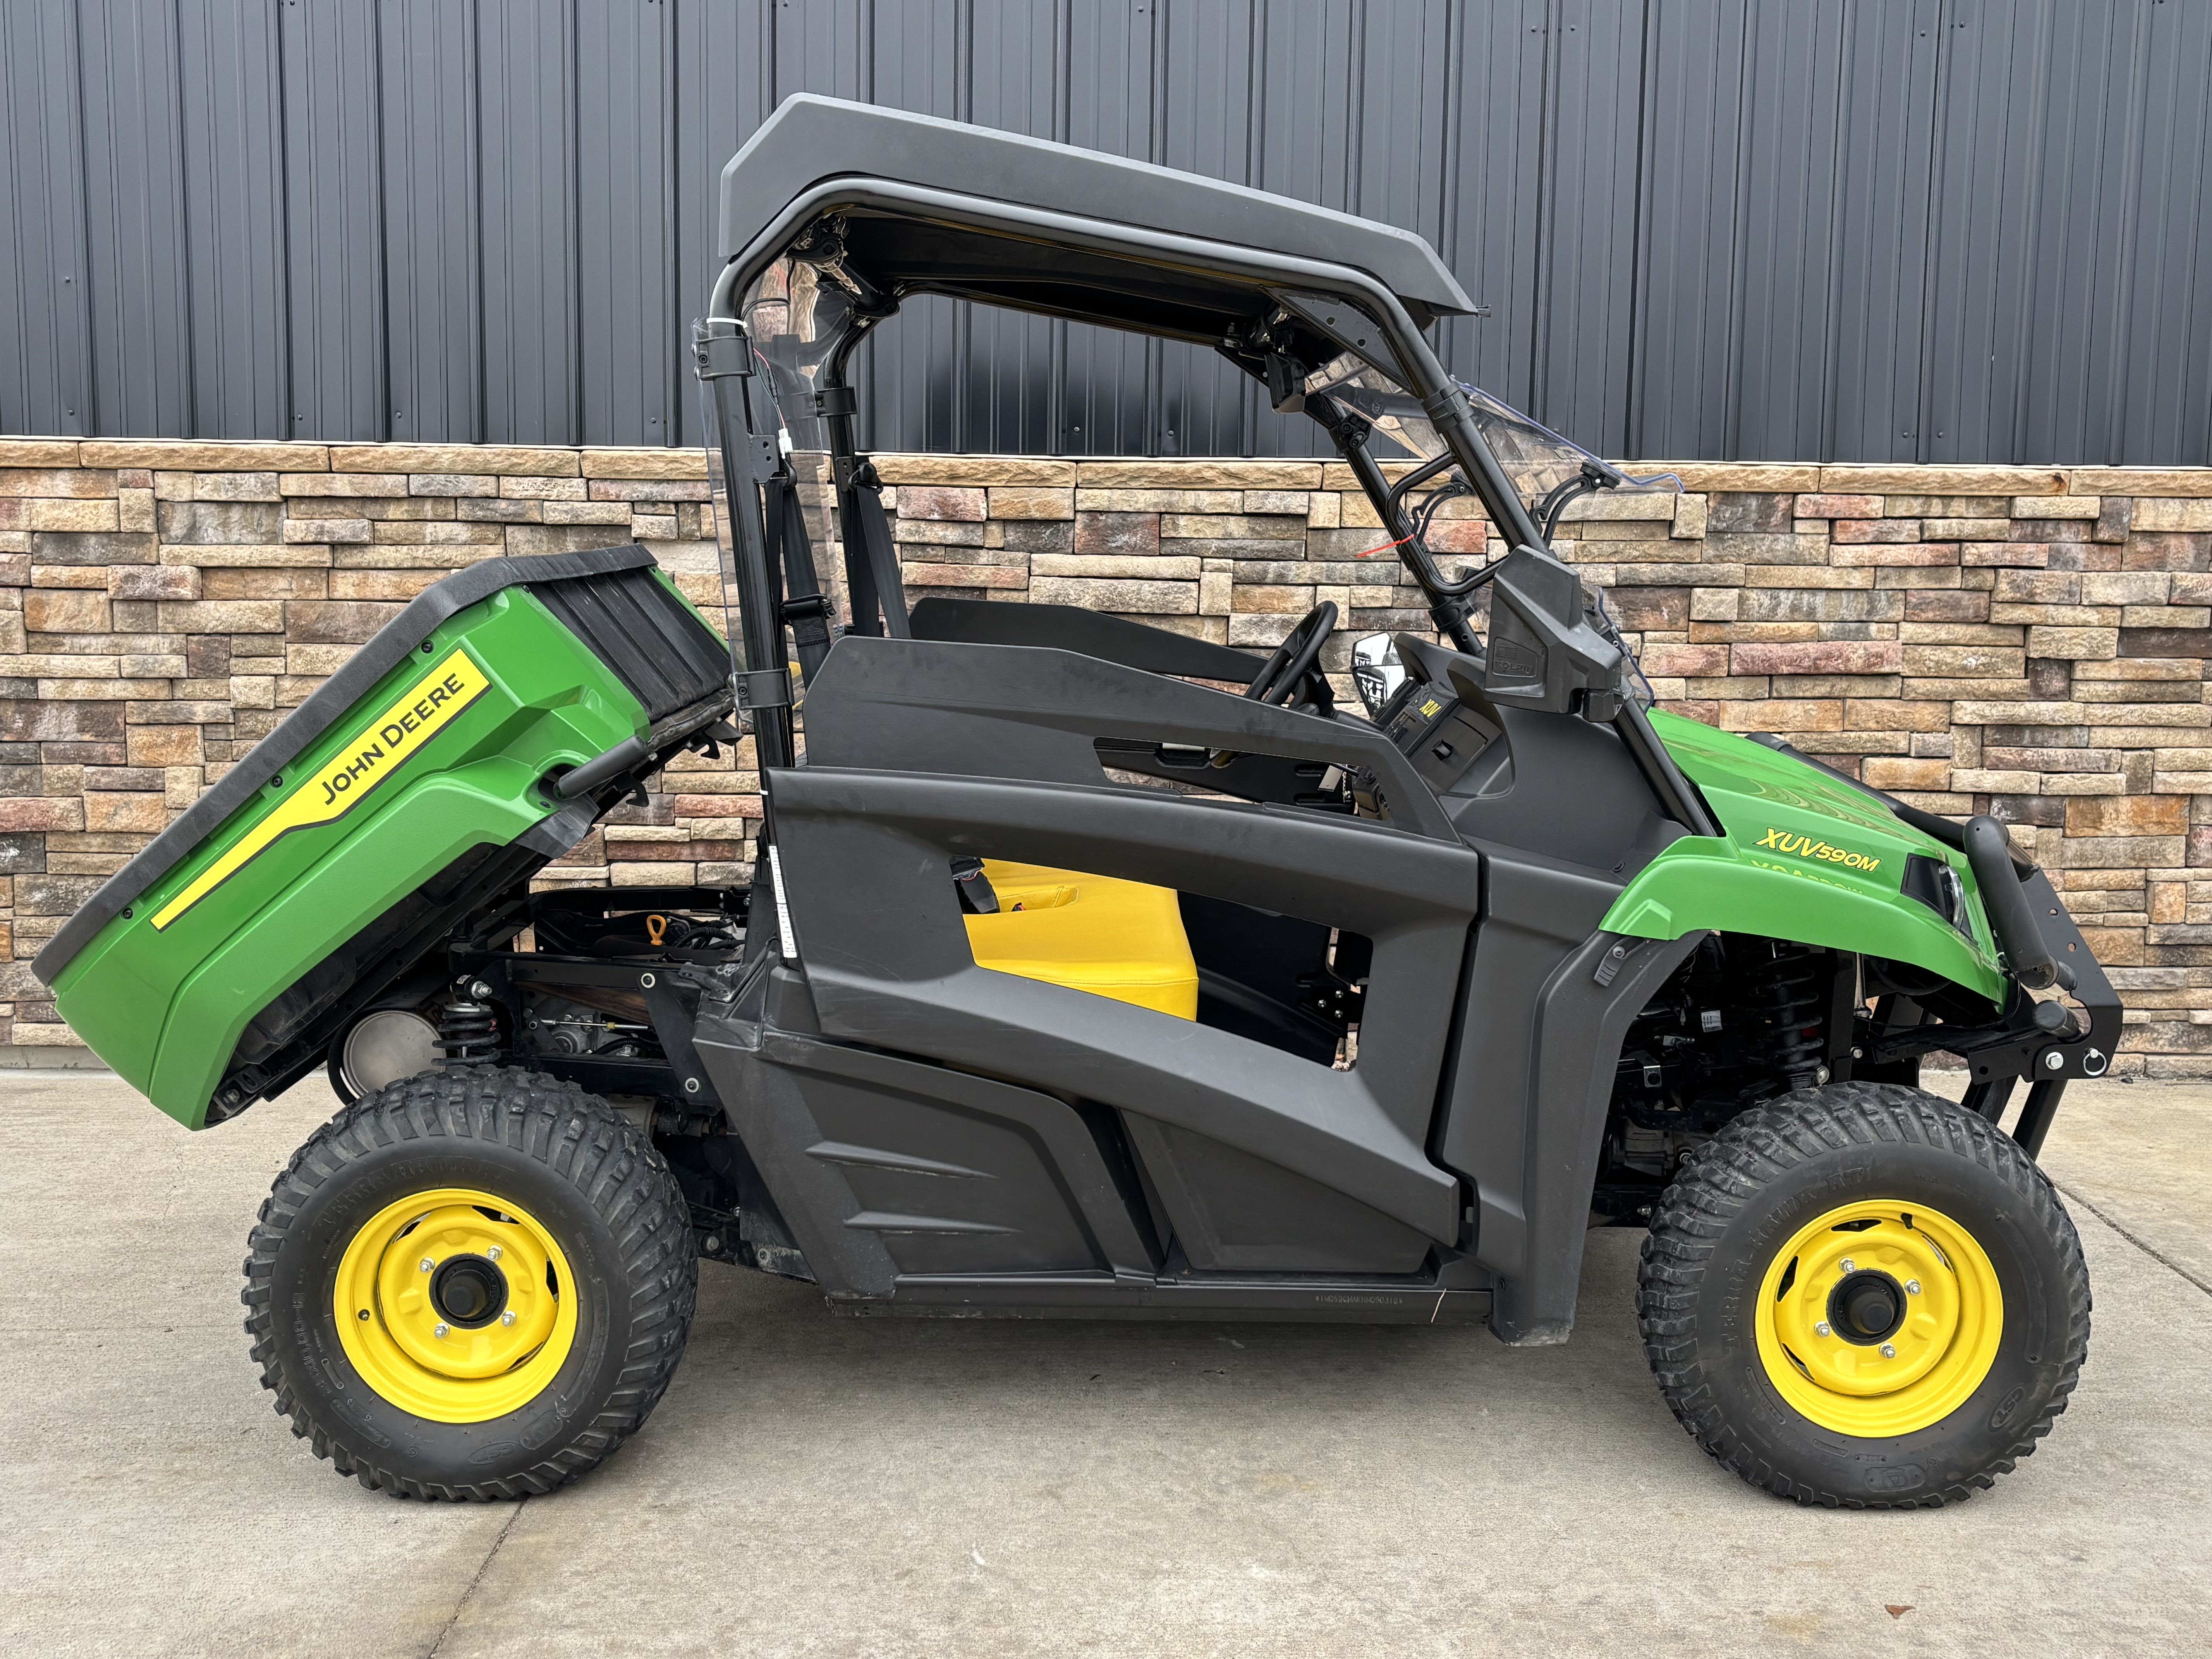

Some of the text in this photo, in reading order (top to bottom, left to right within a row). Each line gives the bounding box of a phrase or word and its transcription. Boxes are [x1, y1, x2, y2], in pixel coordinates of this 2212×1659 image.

[1494, 661, 1534, 674] KOLPIN
[1419, 699, 1442, 718] XUV
[322, 673, 465, 805] JOHN DEERE
[1753, 827, 1881, 872] XUV590M
[1996, 1388, 2024, 1424] CST
